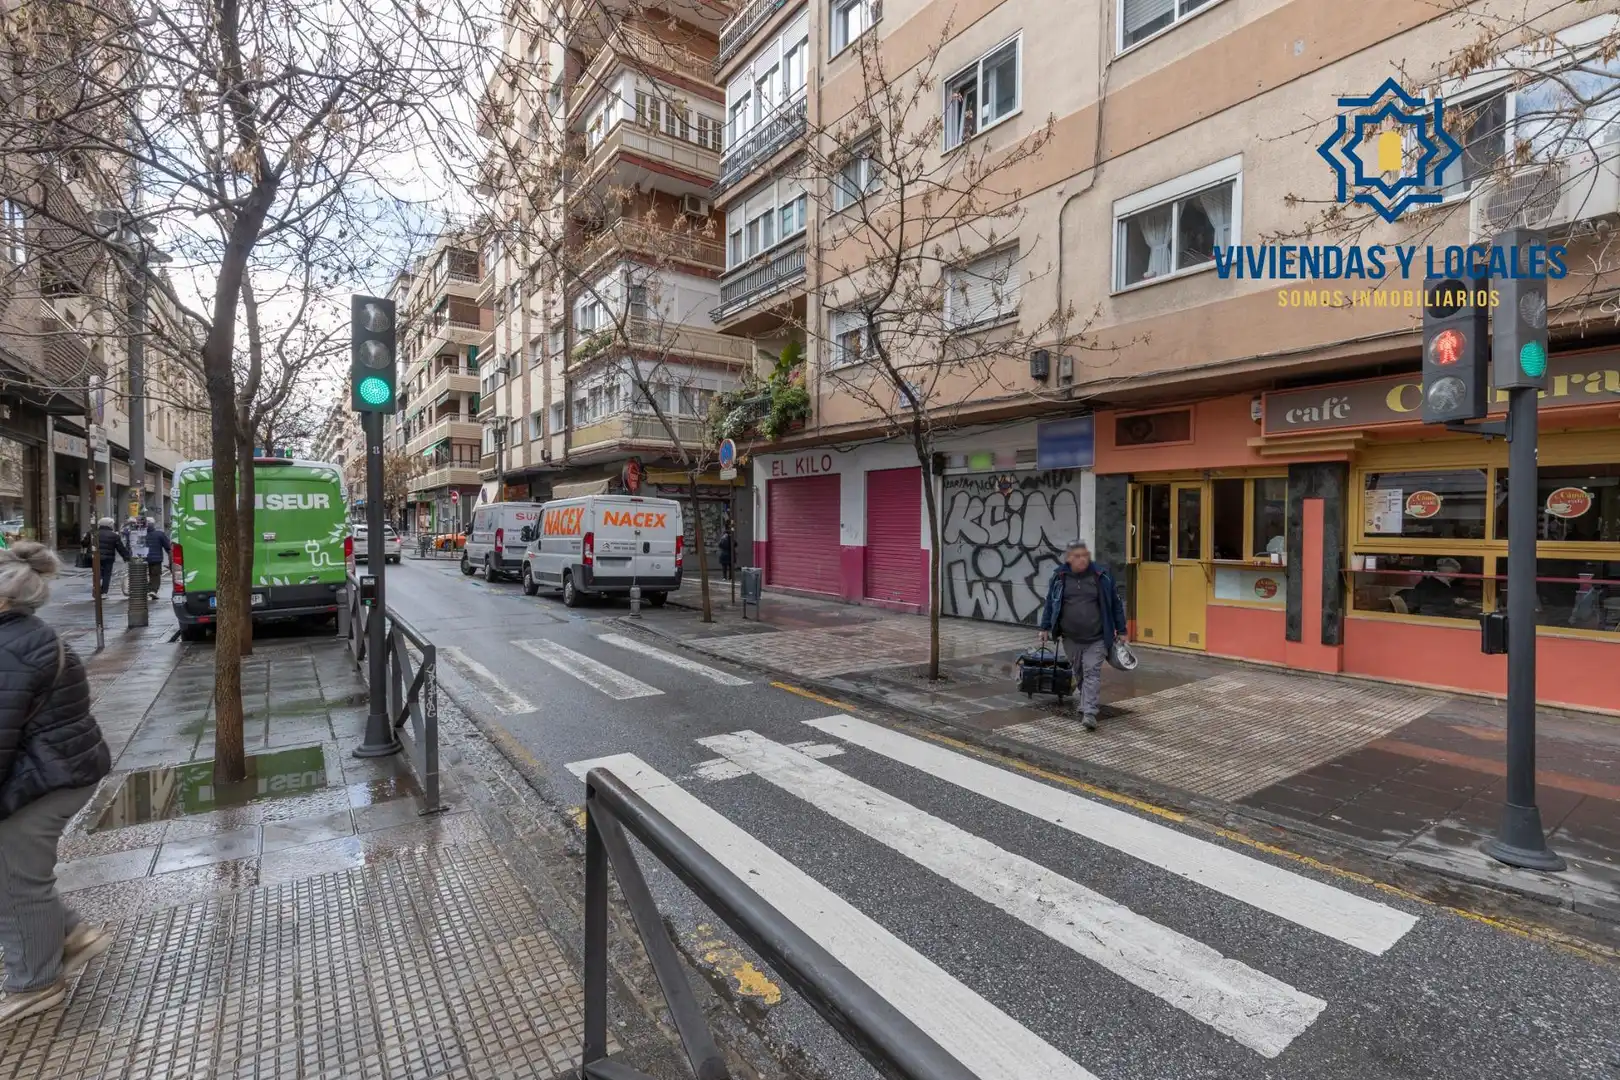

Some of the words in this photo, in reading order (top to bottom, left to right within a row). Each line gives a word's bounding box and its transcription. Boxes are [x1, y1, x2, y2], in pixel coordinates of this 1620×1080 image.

[1285, 396, 1350, 424] café
[772, 460, 788, 476] EL
[796, 454, 832, 474] KILO
[266, 493, 330, 510] SEUR
[544, 507, 585, 535] NACEX
[603, 510, 667, 529] NACEX
